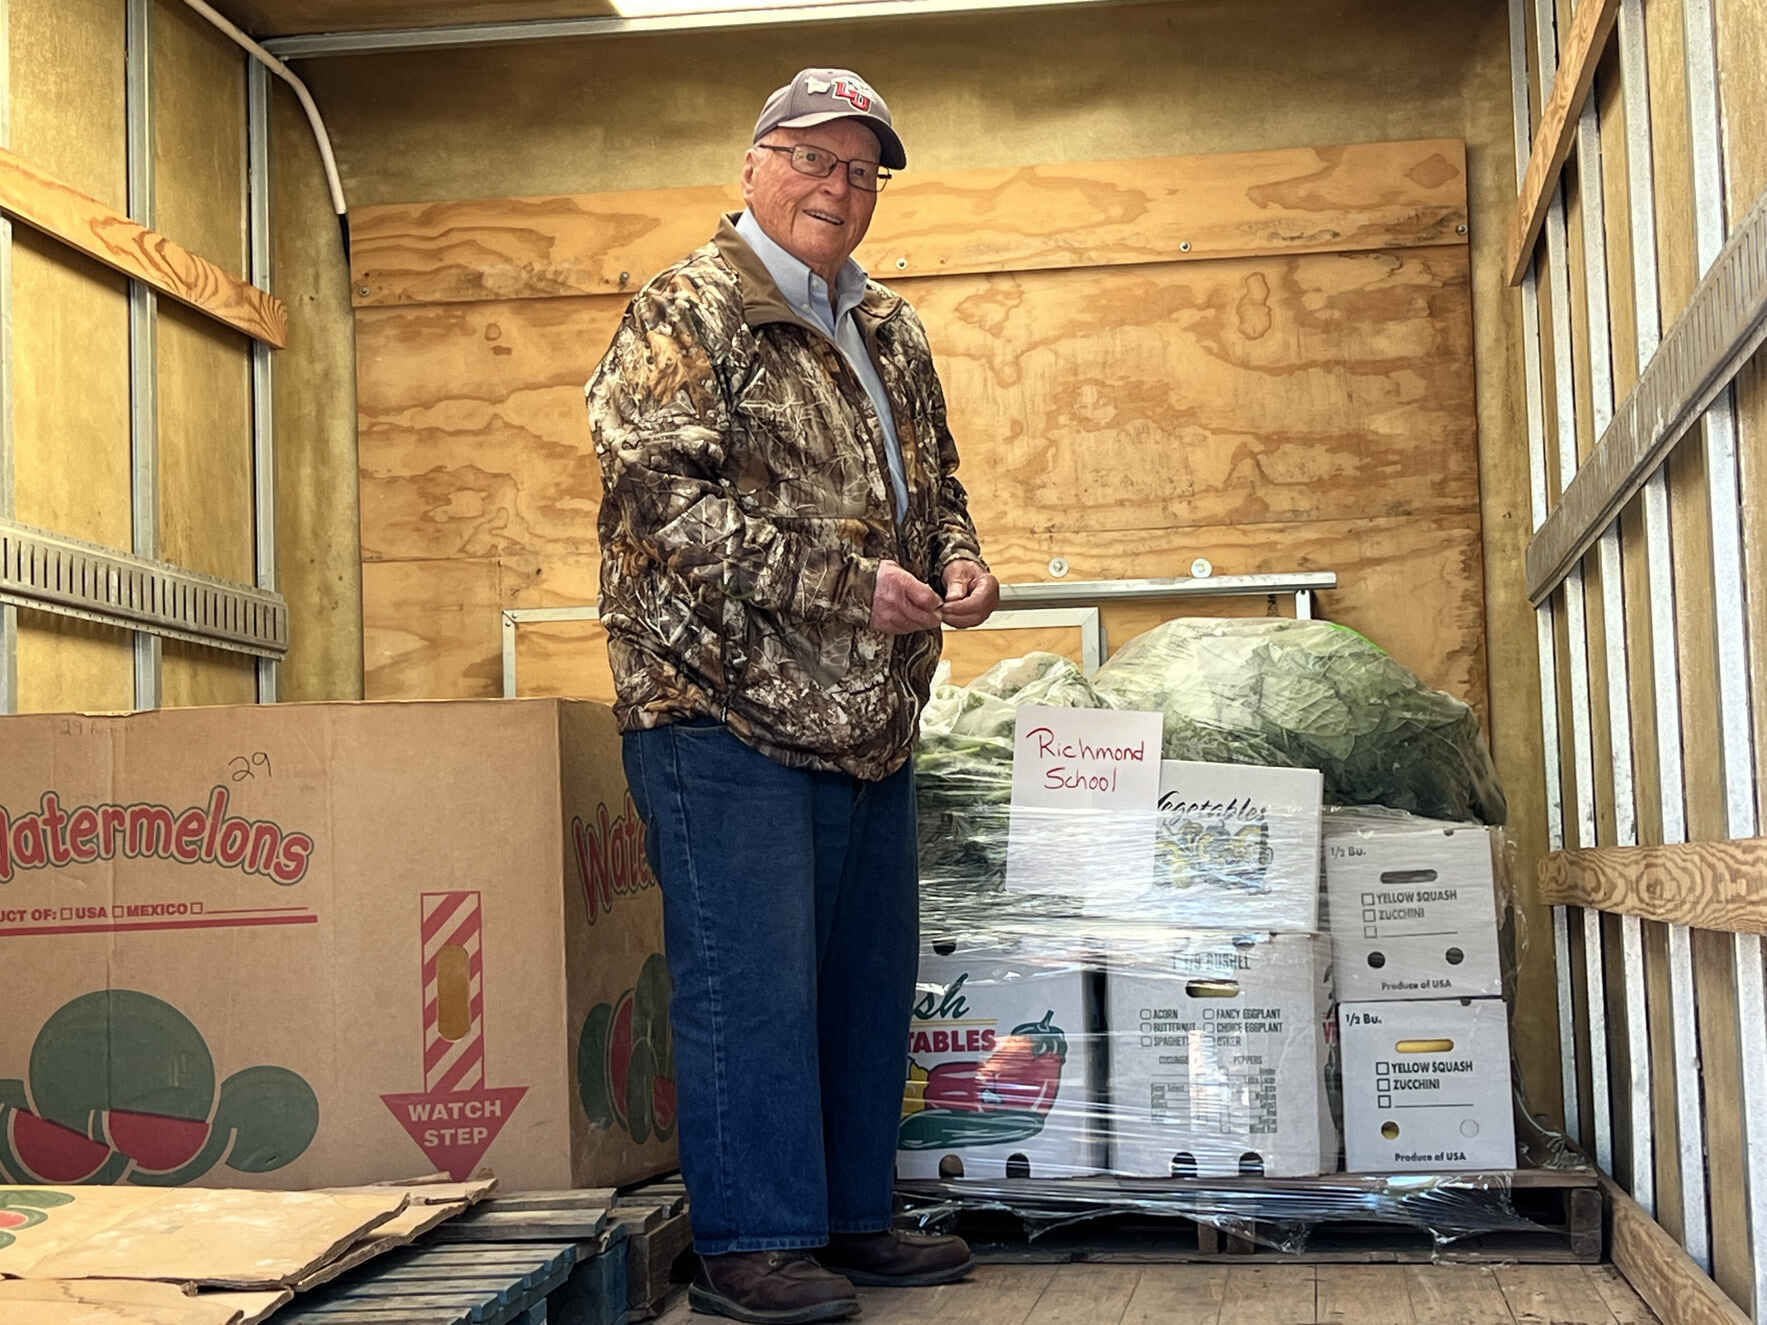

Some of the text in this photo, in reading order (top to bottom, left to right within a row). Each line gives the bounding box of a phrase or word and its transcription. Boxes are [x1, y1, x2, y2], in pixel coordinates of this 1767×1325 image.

[1026, 727, 1145, 762] Richmond
[227, 751, 273, 782] 29
[1043, 766, 1118, 793] School
[1376, 890, 1458, 905] YELLOW SQUASH
[75, 906, 108, 919] USA
[126, 903, 188, 917] MEXICO
[1378, 907, 1425, 921] ZUCCHINI
[1381, 981, 1418, 991] Produce
[1432, 979, 1452, 989] USA
[1153, 1009, 1178, 1020] ACORN
[1243, 1008, 1281, 1020] EGGPLANT
[1363, 1013, 1383, 1025] Bu.
[1391, 1060, 1473, 1074] YELLOW SQUASH
[1393, 1078, 1440, 1091] ZUCCHINI
[408, 1099, 502, 1122] WATCH
[424, 1127, 488, 1147] STEP
[1394, 1152, 1433, 1162] Produce
[1446, 1151, 1466, 1161] USA
